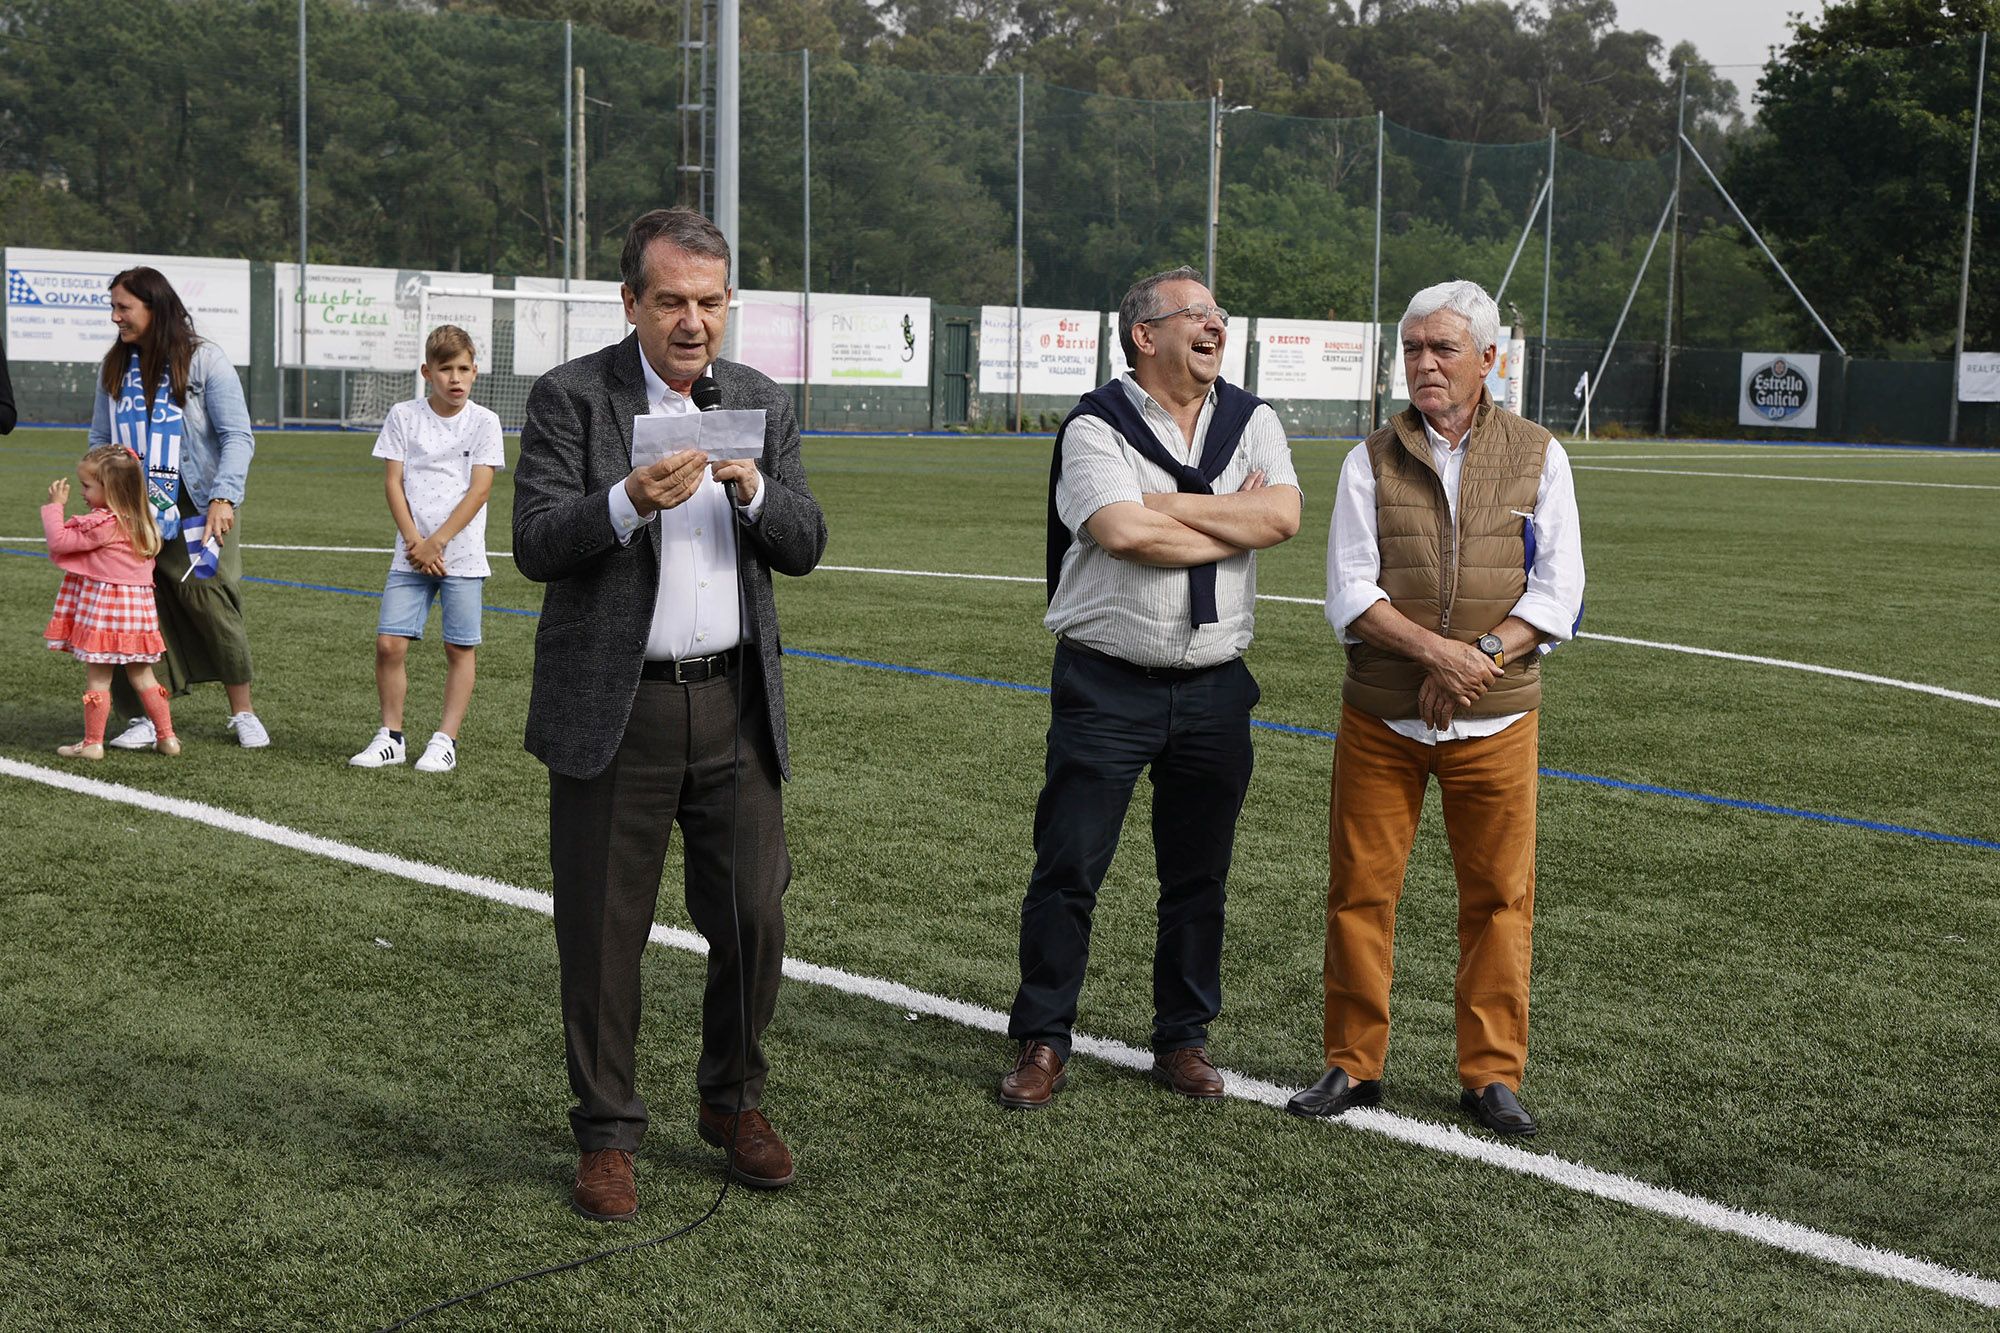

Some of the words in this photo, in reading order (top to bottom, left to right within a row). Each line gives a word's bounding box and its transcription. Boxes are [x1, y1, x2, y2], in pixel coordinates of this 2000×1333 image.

[33, 277, 59, 287] AUTO
[61, 278, 102, 289] ESCUELA
[294, 286, 376, 306] Eusebio
[323, 305, 390, 326] Costas
[1059, 318, 1080, 332] Bar
[1040, 334, 1051, 349] O
[1056, 334, 1096, 350] Barxio
[1269, 335, 1275, 345] O
[1754, 374, 1803, 391] Estrella
[1756, 390, 1800, 407] Galicia
